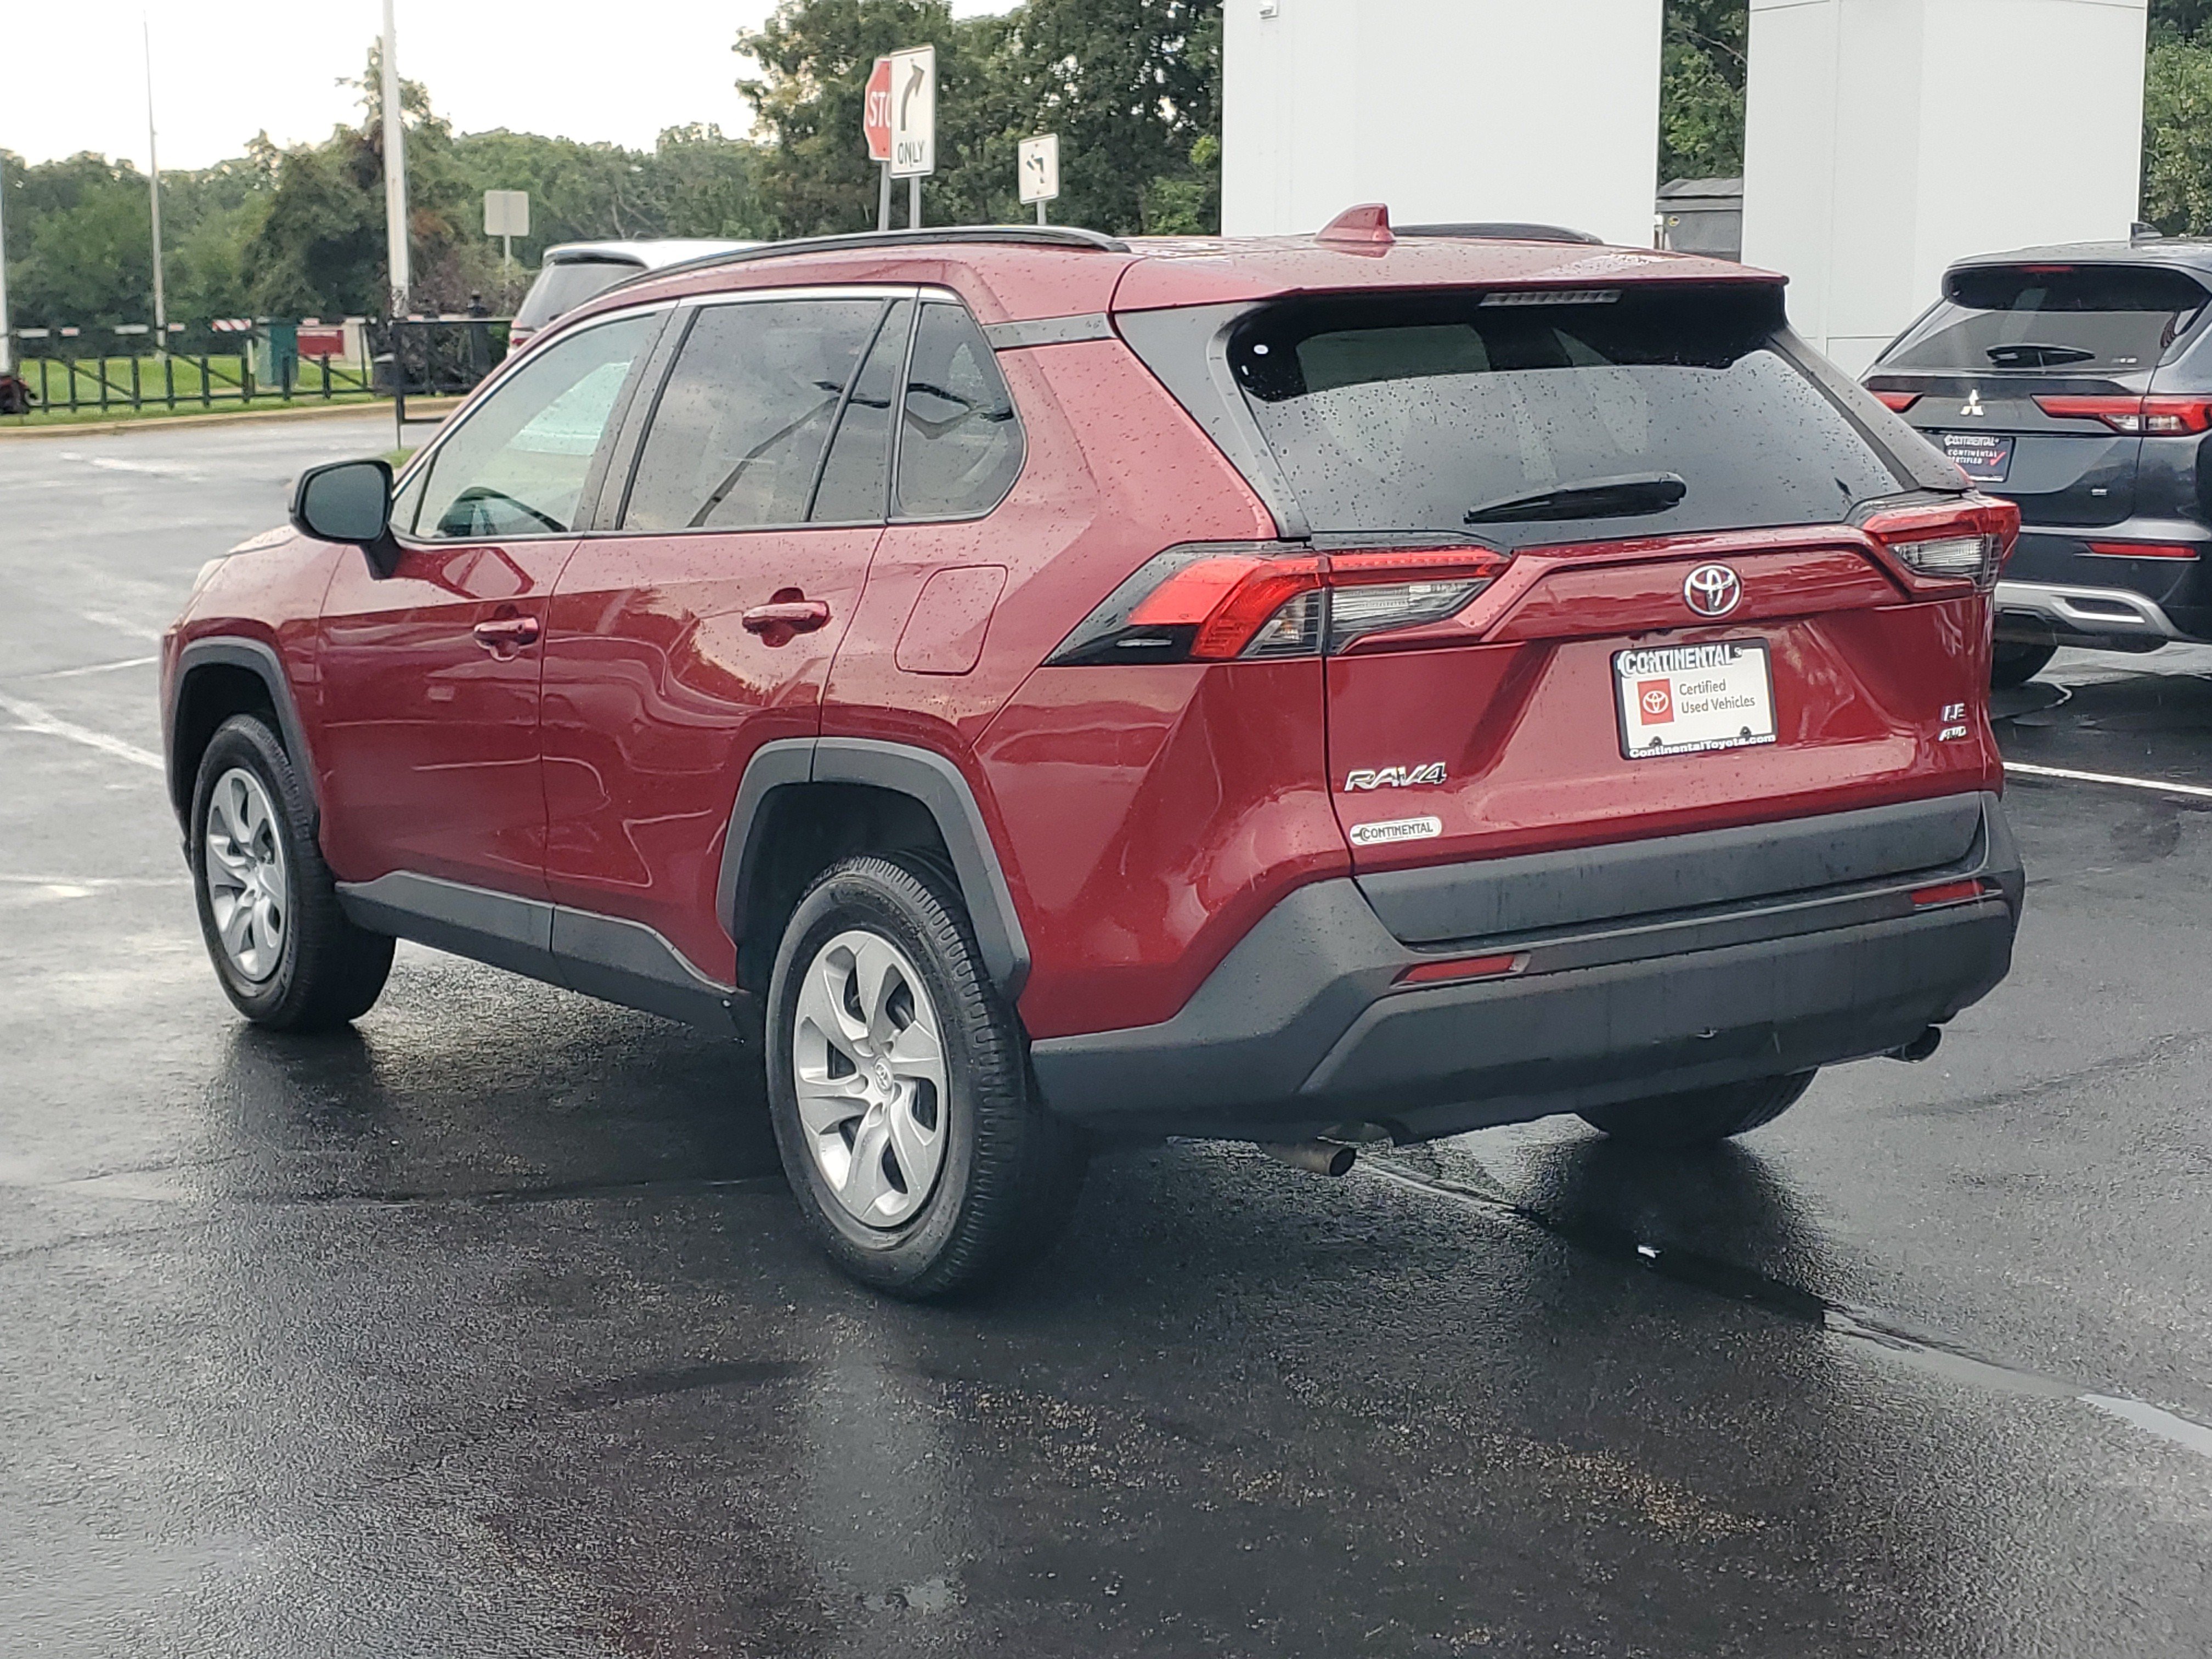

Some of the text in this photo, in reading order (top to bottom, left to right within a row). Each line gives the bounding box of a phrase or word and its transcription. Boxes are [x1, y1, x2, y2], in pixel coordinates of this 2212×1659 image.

[868, 91, 891, 128] STO
[898, 140, 924, 166] ONLY
[1679, 679, 1726, 696] Certified
[1681, 695, 1756, 714] Used Vehicles
[1944, 703, 1966, 721] LE
[1629, 734, 1776, 758] ContinentalToyota.com
[1344, 762, 1447, 791] RAV4
[1361, 822, 1434, 842] CONTINENTAL
